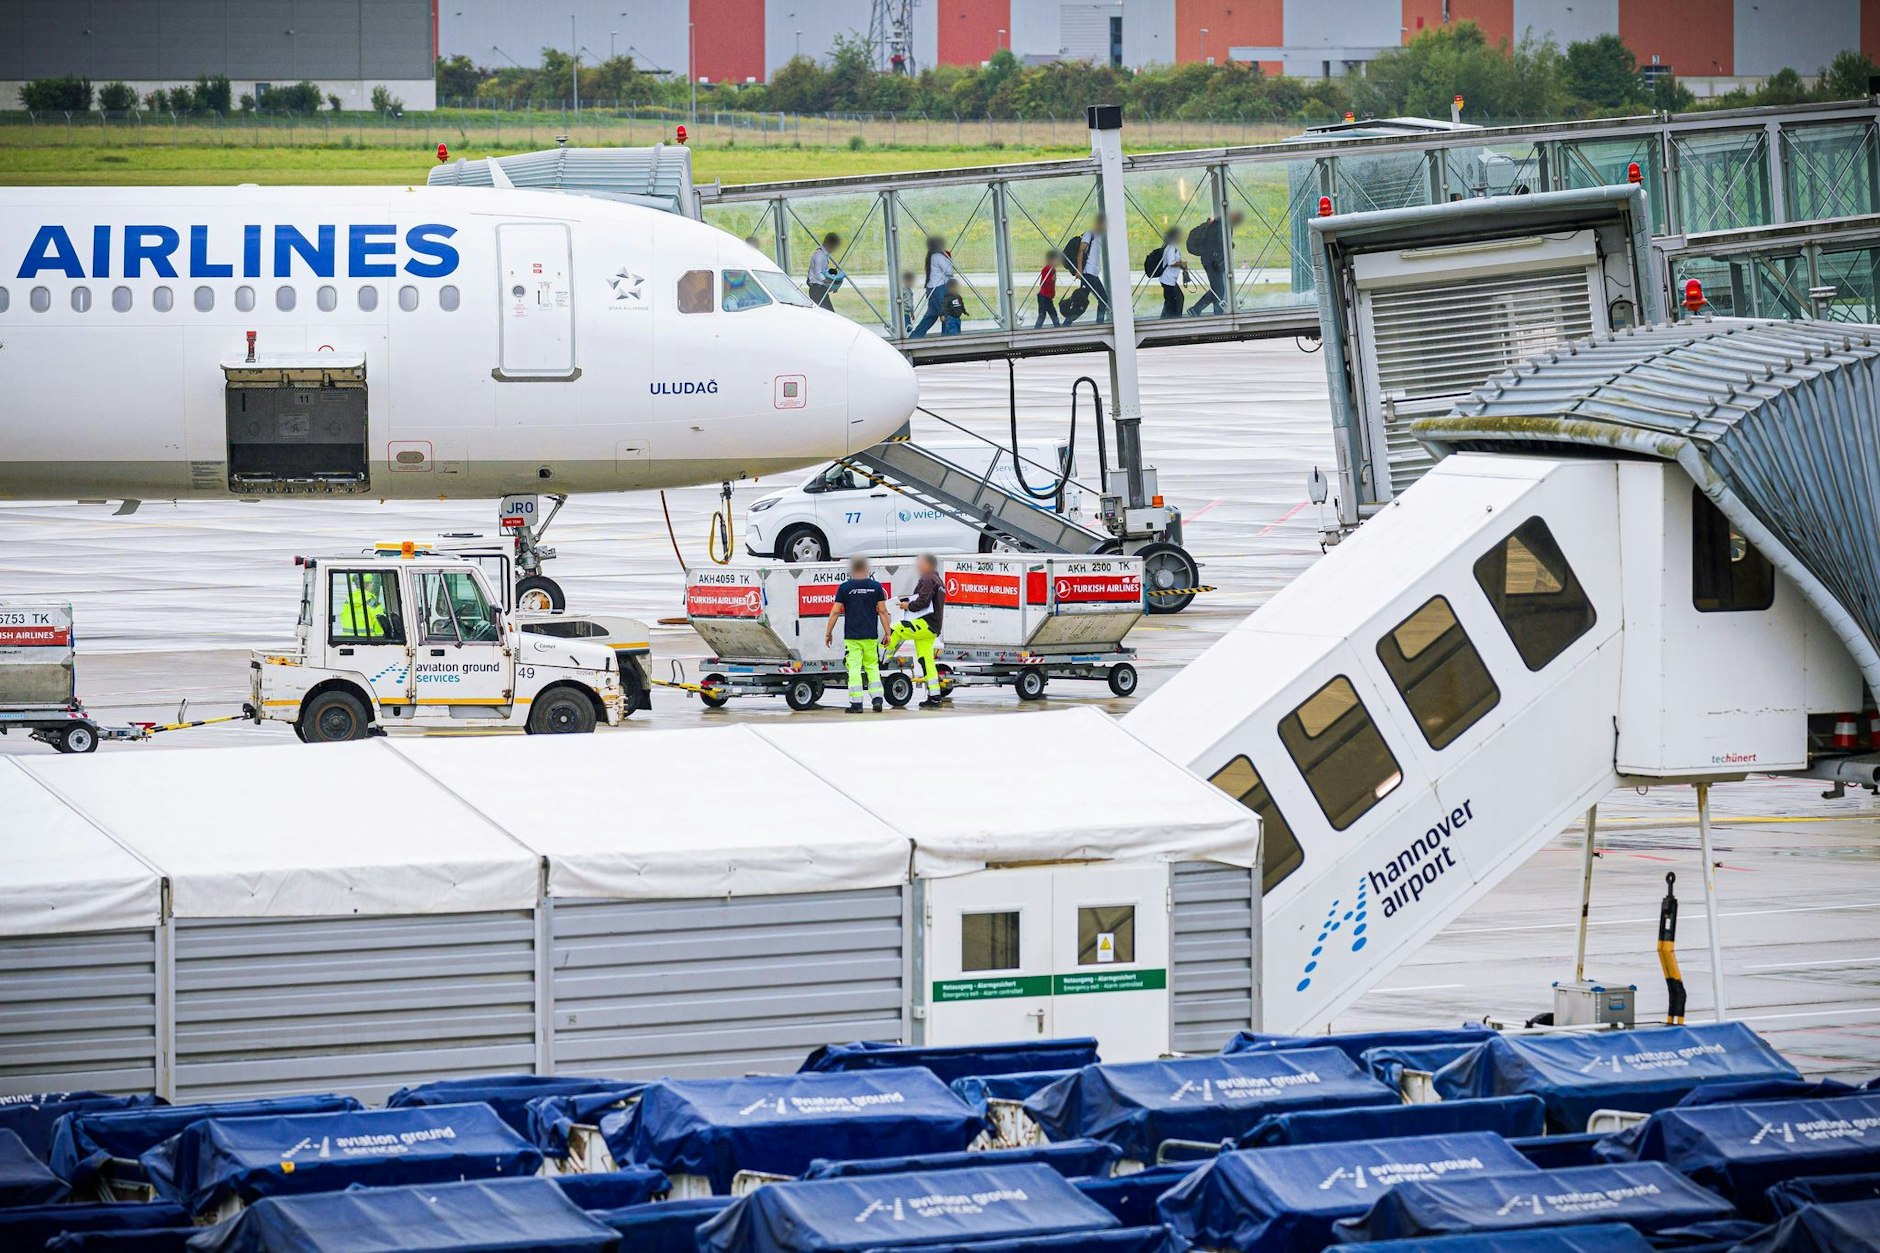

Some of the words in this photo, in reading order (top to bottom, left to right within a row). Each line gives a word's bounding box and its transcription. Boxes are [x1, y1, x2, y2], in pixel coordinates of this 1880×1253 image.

[16, 224, 460, 279] AIRLINES
[650, 379, 719, 395] ULUDAĞ
[299, 395, 310, 404] 11
[845, 512, 862, 524] 77
[956, 562, 972, 571] AKH
[999, 562, 1009, 572] TK
[1068, 563, 1086, 573] AKH
[1092, 562, 1112, 572] 2300
[1118, 561, 1130, 571] TK
[740, 575, 750, 584] TK
[960, 583, 988, 593] TURKISH
[989, 585, 1018, 595] AIRLINES
[1072, 584, 1105, 593] TURKISH
[1106, 583, 1139, 592] AIRLINES
[689, 596, 717, 604] TURKISH
[718, 595, 747, 605] AIRLINES
[801, 595, 835, 604] TURKISH
[32, 613, 50, 624] TK
[16, 631, 54, 640] AIRLINES
[416, 662, 457, 672] aviation
[462, 661, 500, 675] ground
[517, 667, 535, 679] 49
[416, 673, 461, 683] services
[1711, 752, 1757, 764] techünert
[1368, 798, 1474, 895] hannover
[1381, 846, 1457, 918] airport
[1678, 1043, 1727, 1060] ground
[1215, 1076, 1271, 1089] aviation
[1271, 1071, 1322, 1089] ground
[1224, 1086, 1283, 1099] services
[336, 1134, 398, 1148] aviation
[400, 1126, 457, 1146] ground
[343, 1143, 409, 1156] services
